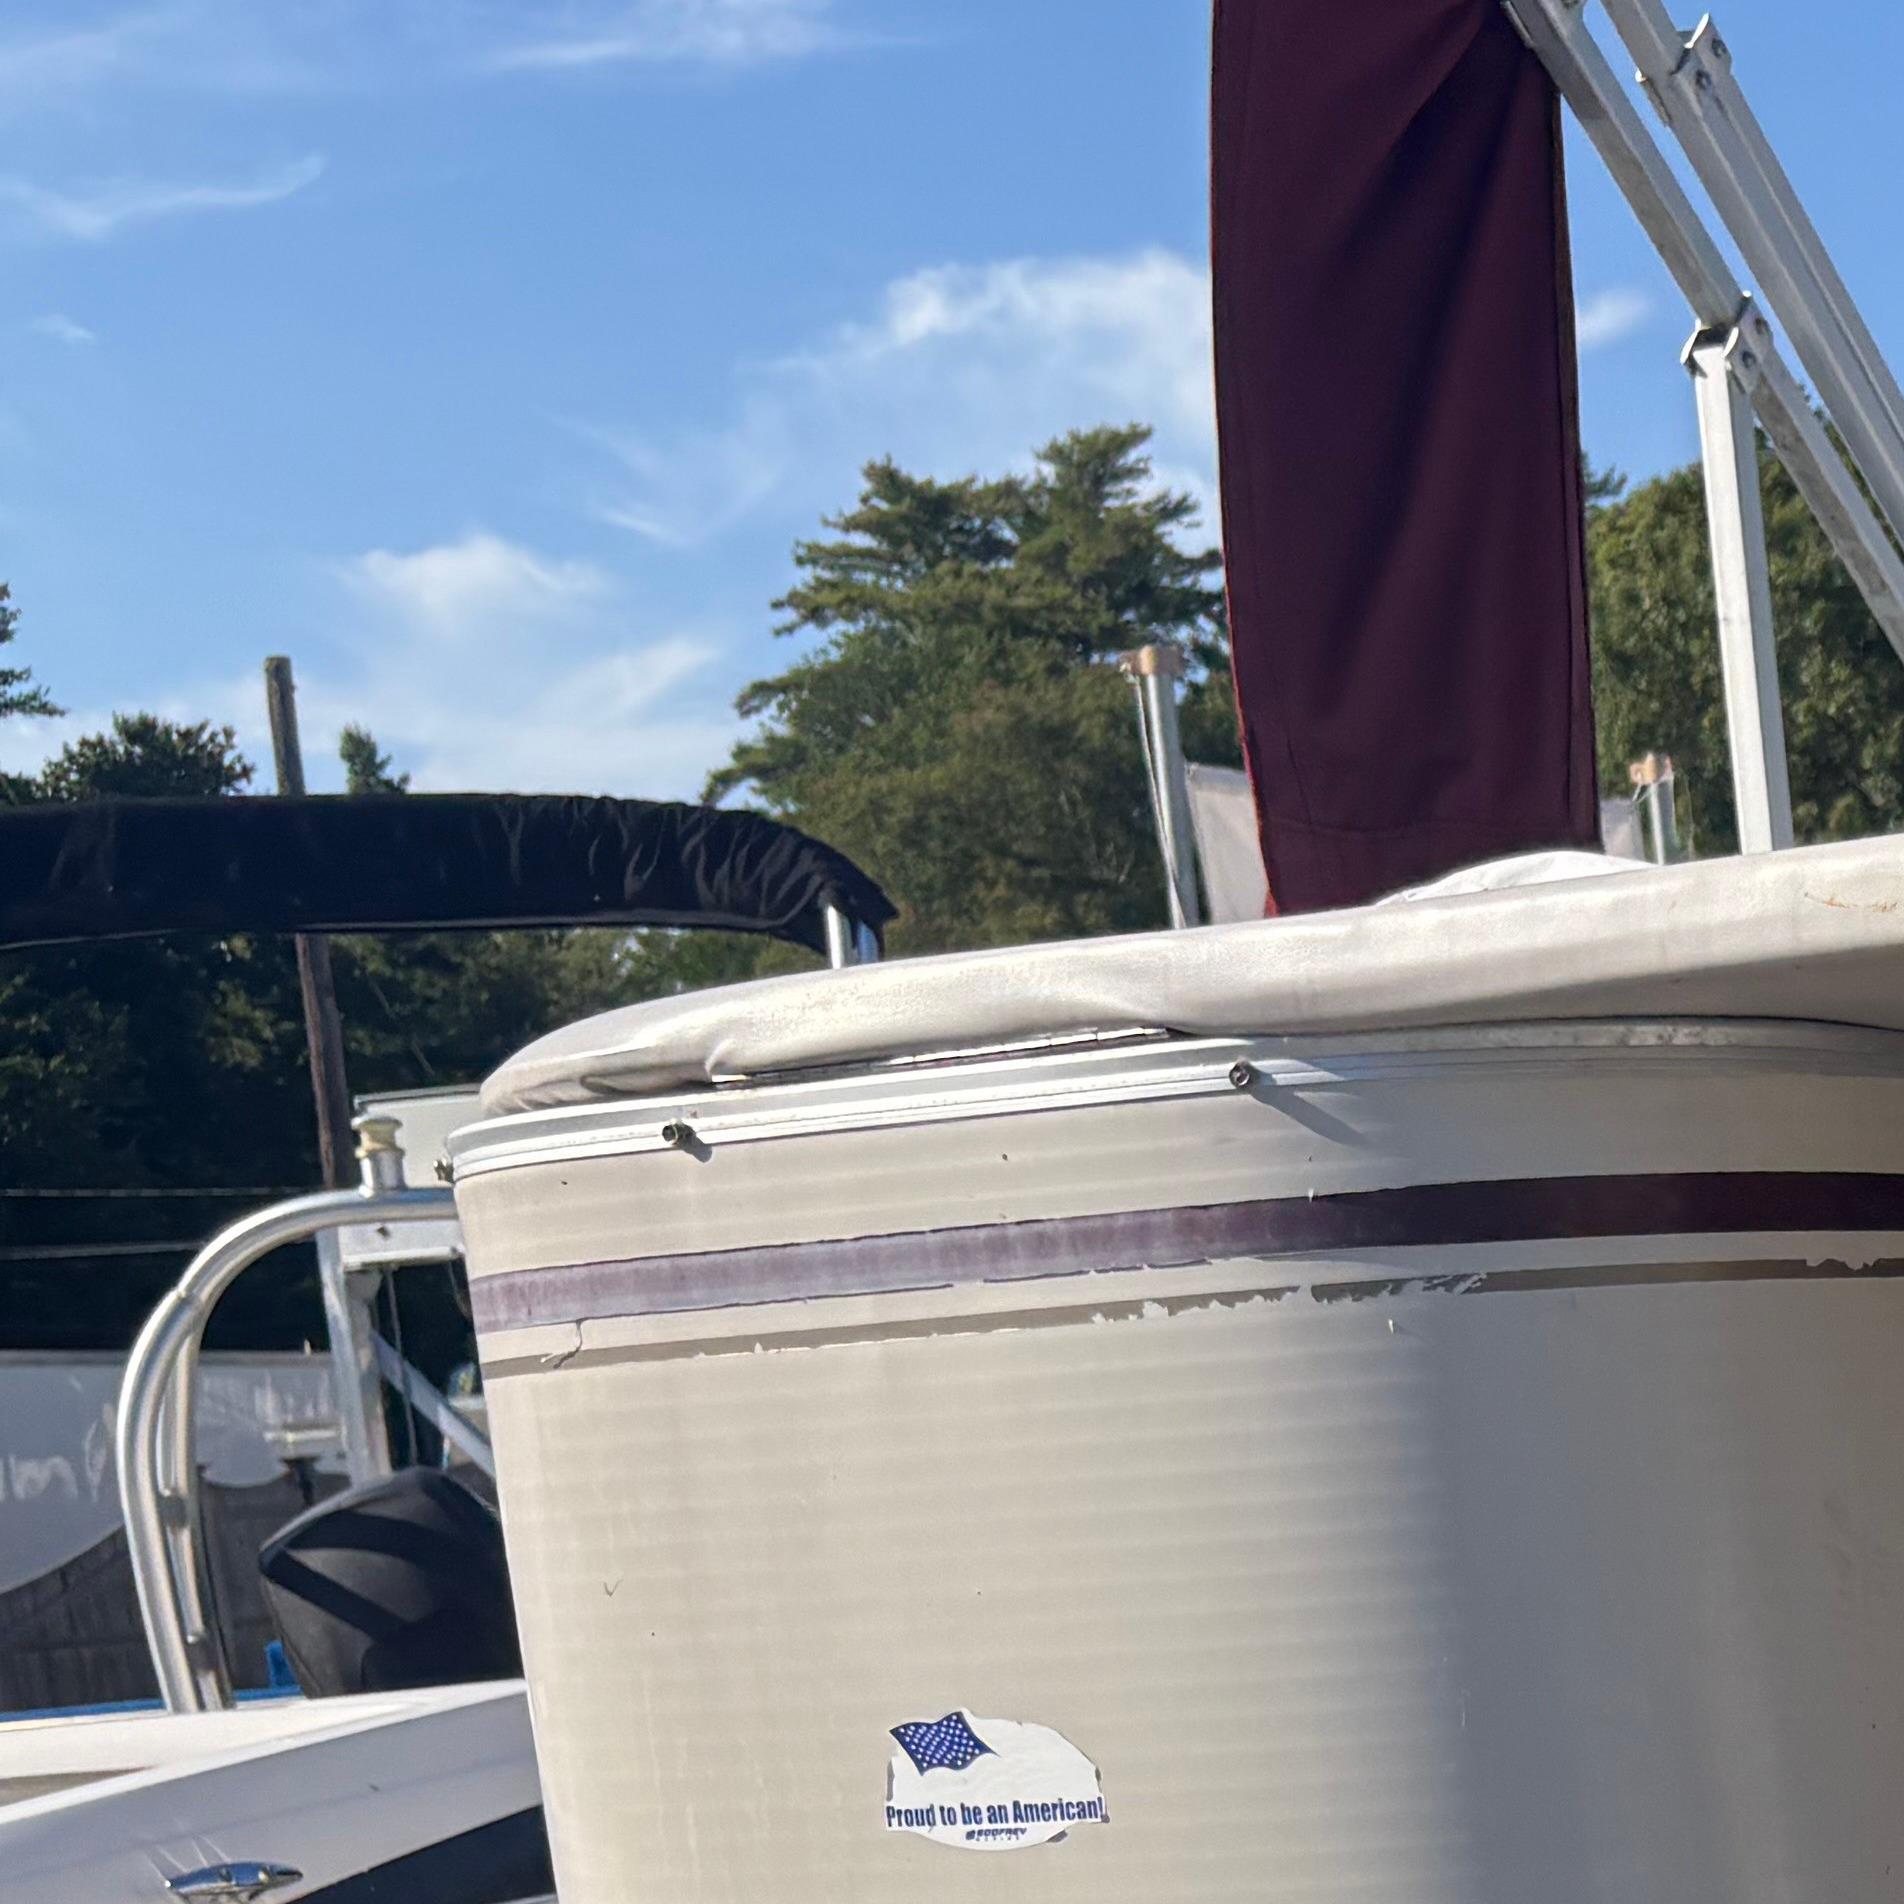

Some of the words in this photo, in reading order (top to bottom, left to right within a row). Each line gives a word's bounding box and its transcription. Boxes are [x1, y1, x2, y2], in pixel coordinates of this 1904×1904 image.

[886, 1803, 935, 1828] Proud
[940, 1804, 957, 1826] to
[961, 1802, 983, 1826] be
[987, 1805, 1009, 1825] an
[1012, 1797, 1104, 1824] American!
